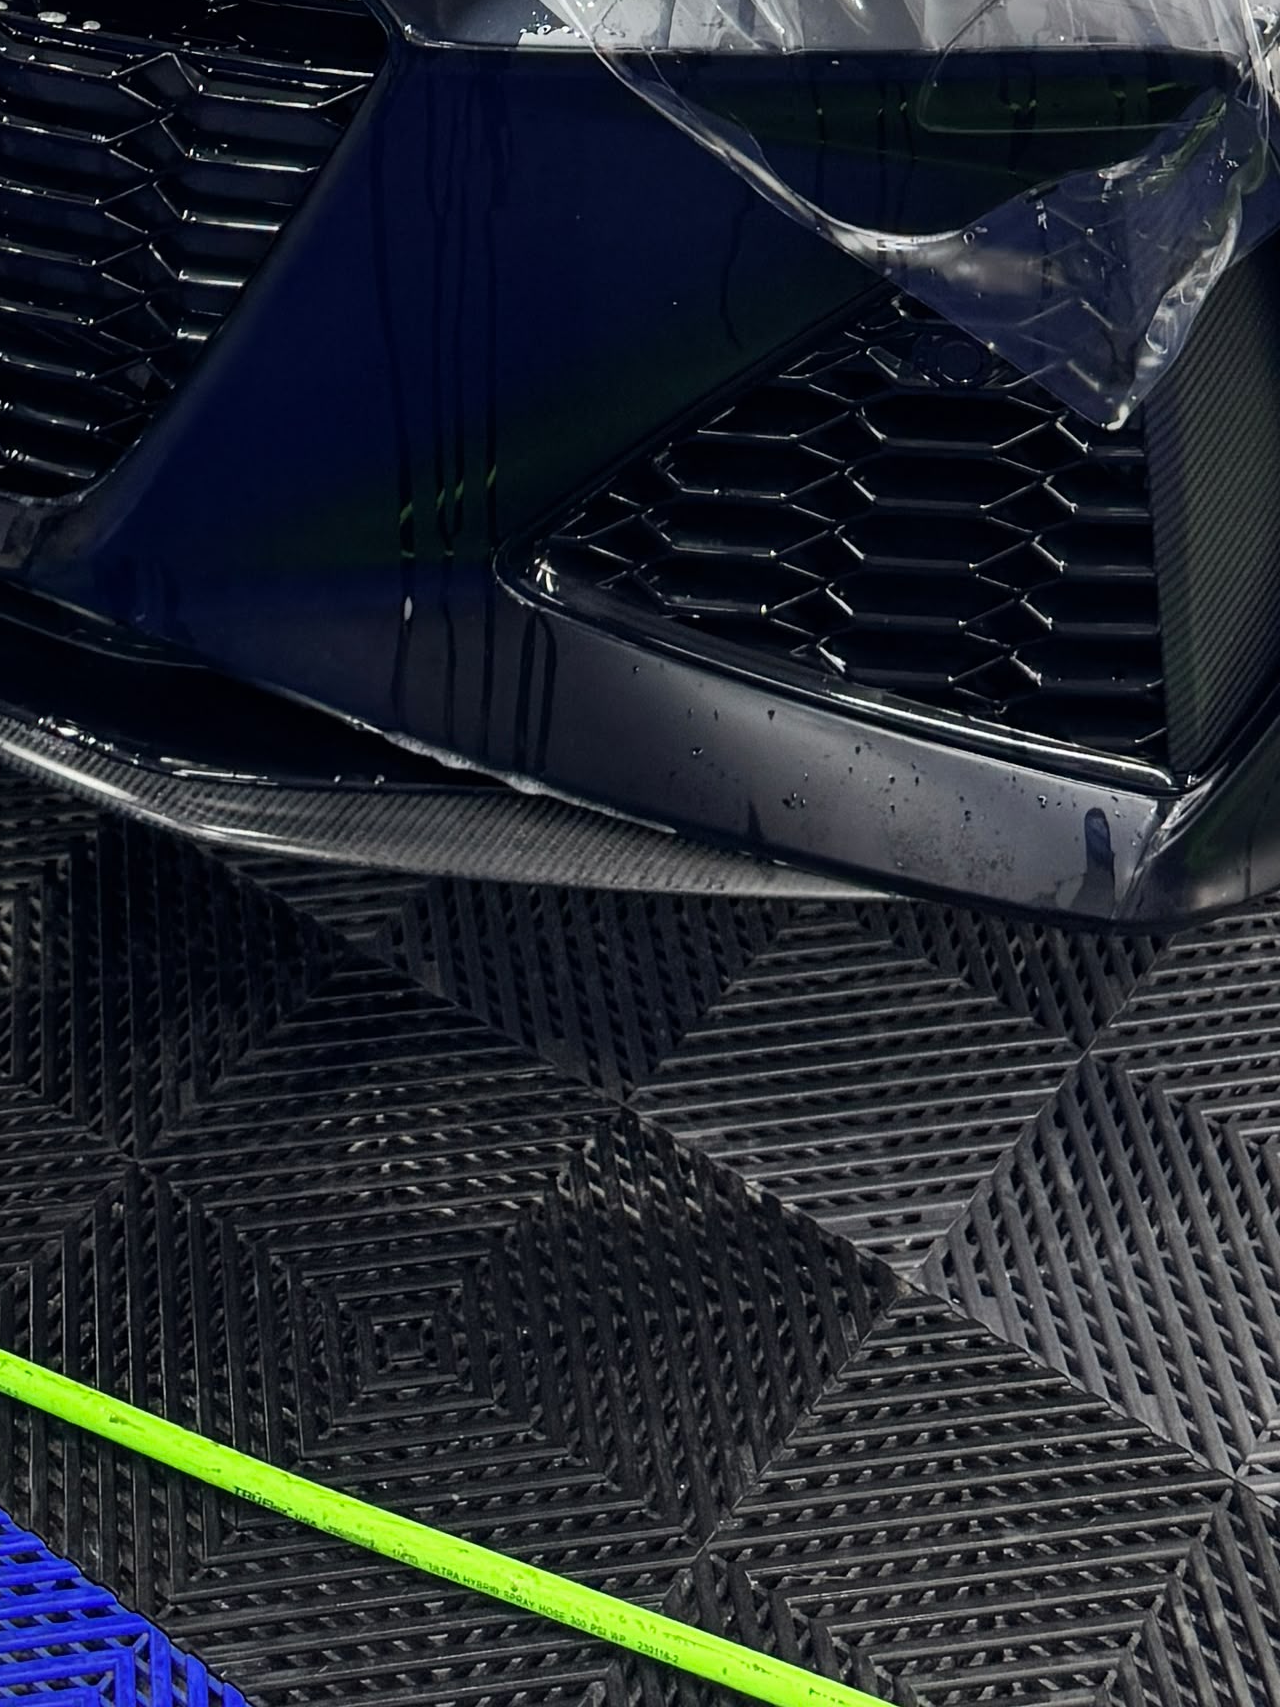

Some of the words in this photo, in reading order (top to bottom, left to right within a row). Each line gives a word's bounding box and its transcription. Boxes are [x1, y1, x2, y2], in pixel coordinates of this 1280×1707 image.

[463, 1574, 500, 1595] HYBRID
[503, 1590, 535, 1607] SPRAY
[538, 1604, 567, 1621] HOSE
